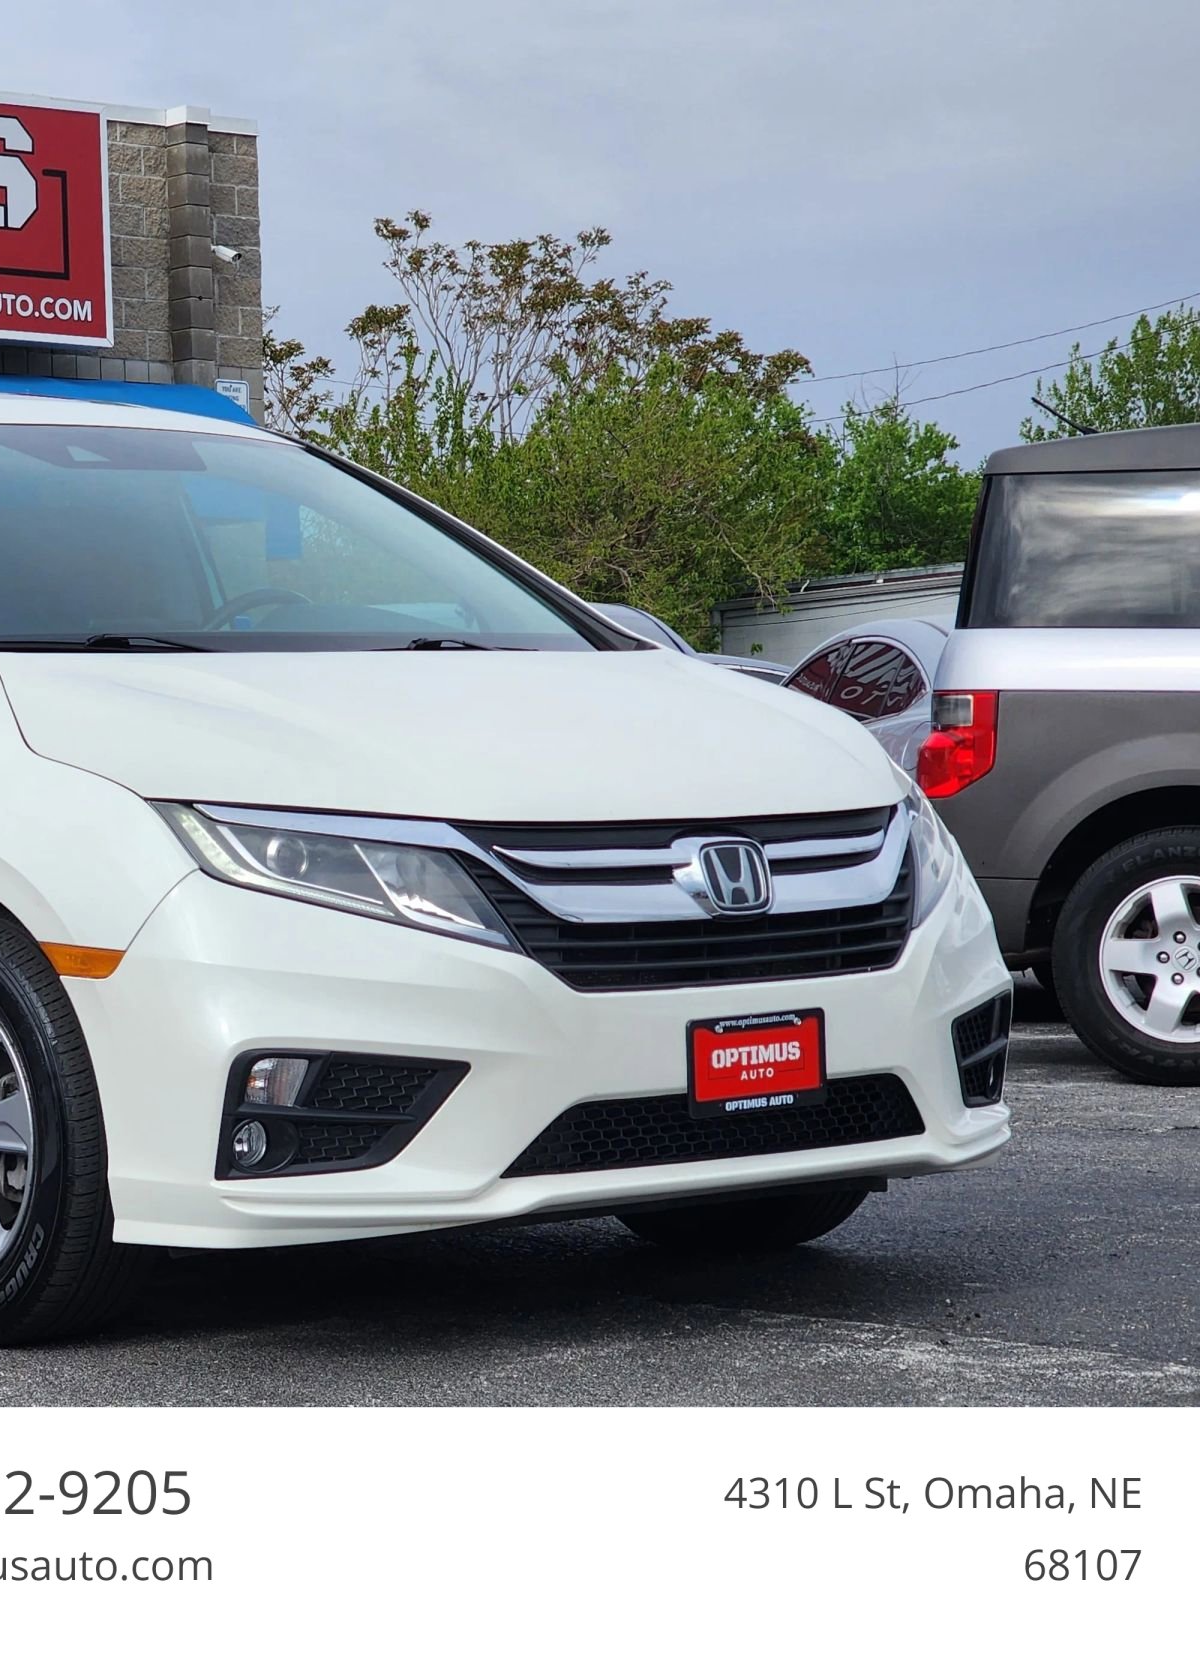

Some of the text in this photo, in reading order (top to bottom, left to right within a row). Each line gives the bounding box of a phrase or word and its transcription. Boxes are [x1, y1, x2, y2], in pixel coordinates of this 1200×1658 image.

[719, 1013, 796, 1029] www.optimusauto.com
[711, 1041, 801, 1069] OPTIMUS
[740, 1067, 775, 1081] AUTO
[725, 1094, 794, 1112] OPTIMUS AUTO
